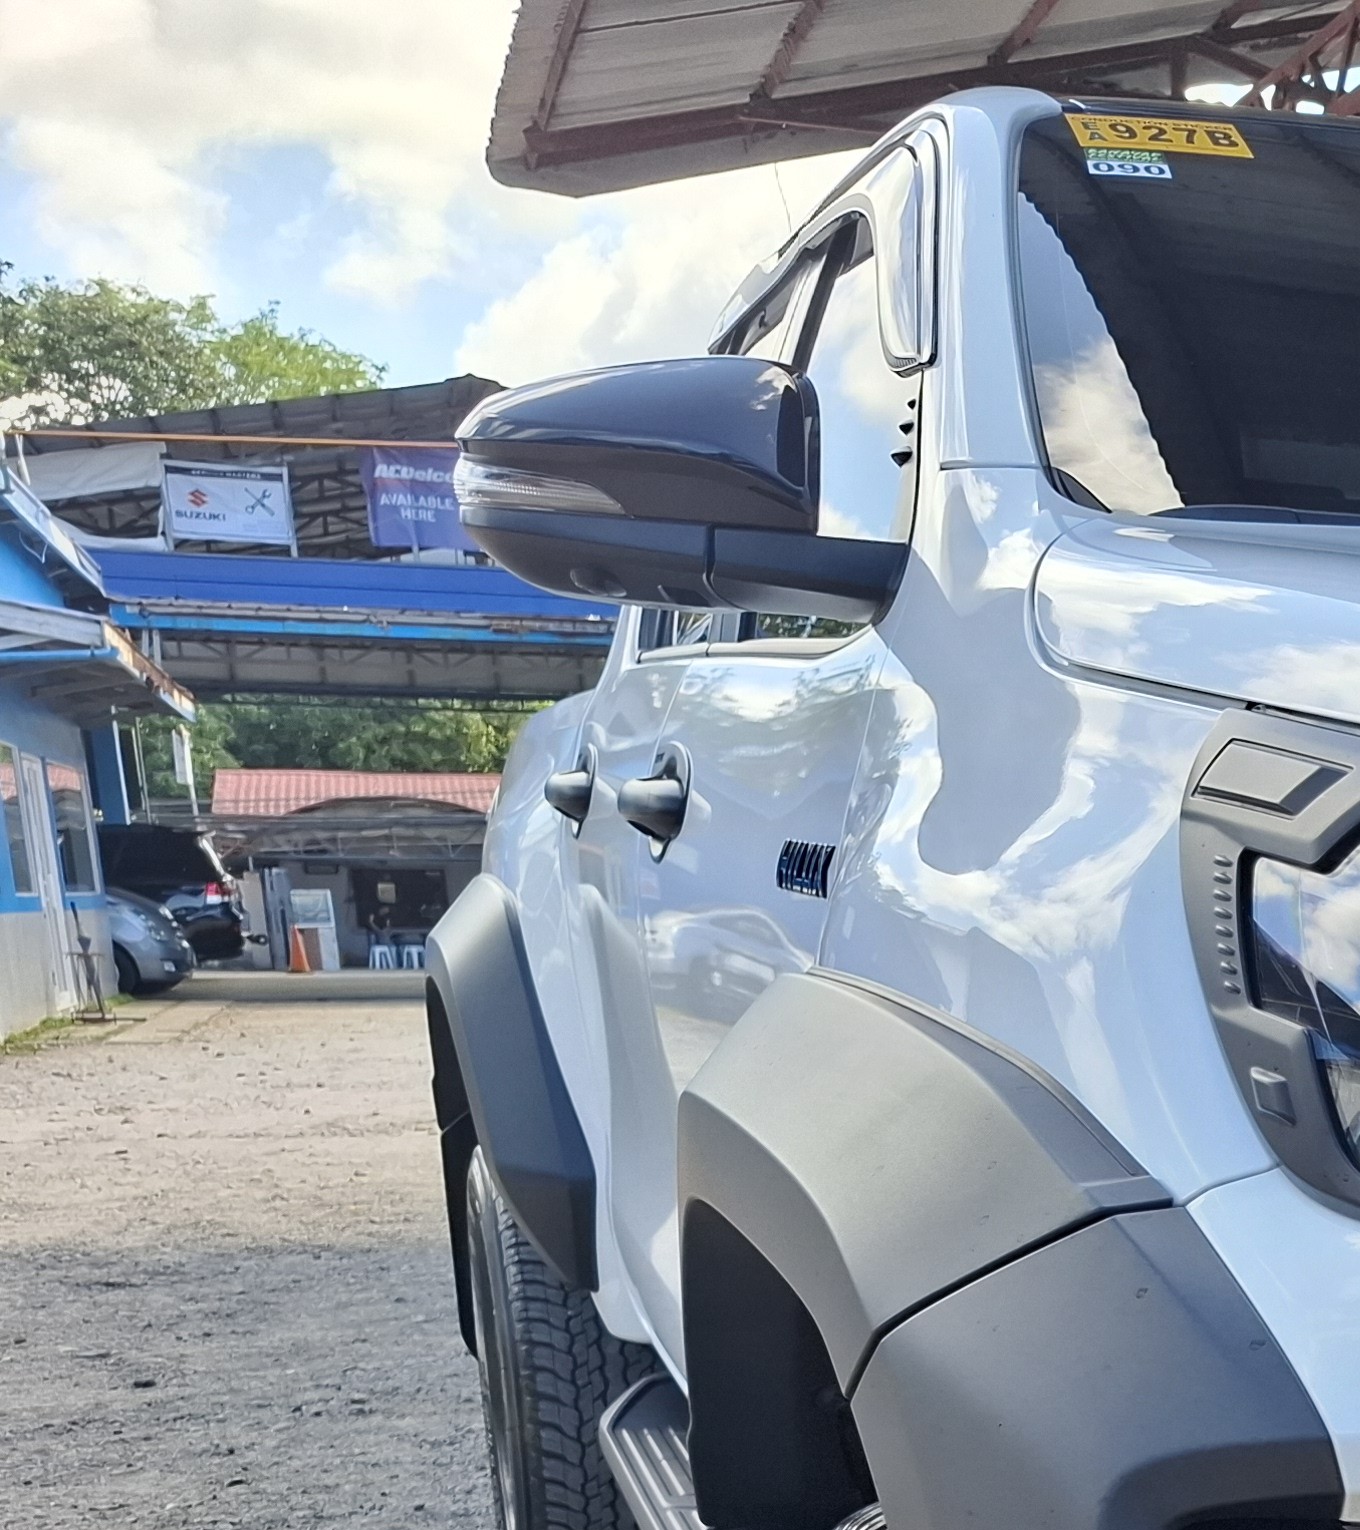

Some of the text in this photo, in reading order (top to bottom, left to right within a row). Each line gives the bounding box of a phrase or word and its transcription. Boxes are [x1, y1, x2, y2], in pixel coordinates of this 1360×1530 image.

[1092, 162, 1166, 175] 090
[380, 492, 455, 511] AVAILABLE
[175, 509, 226, 522] SUZUKI
[401, 507, 436, 522] HERE
